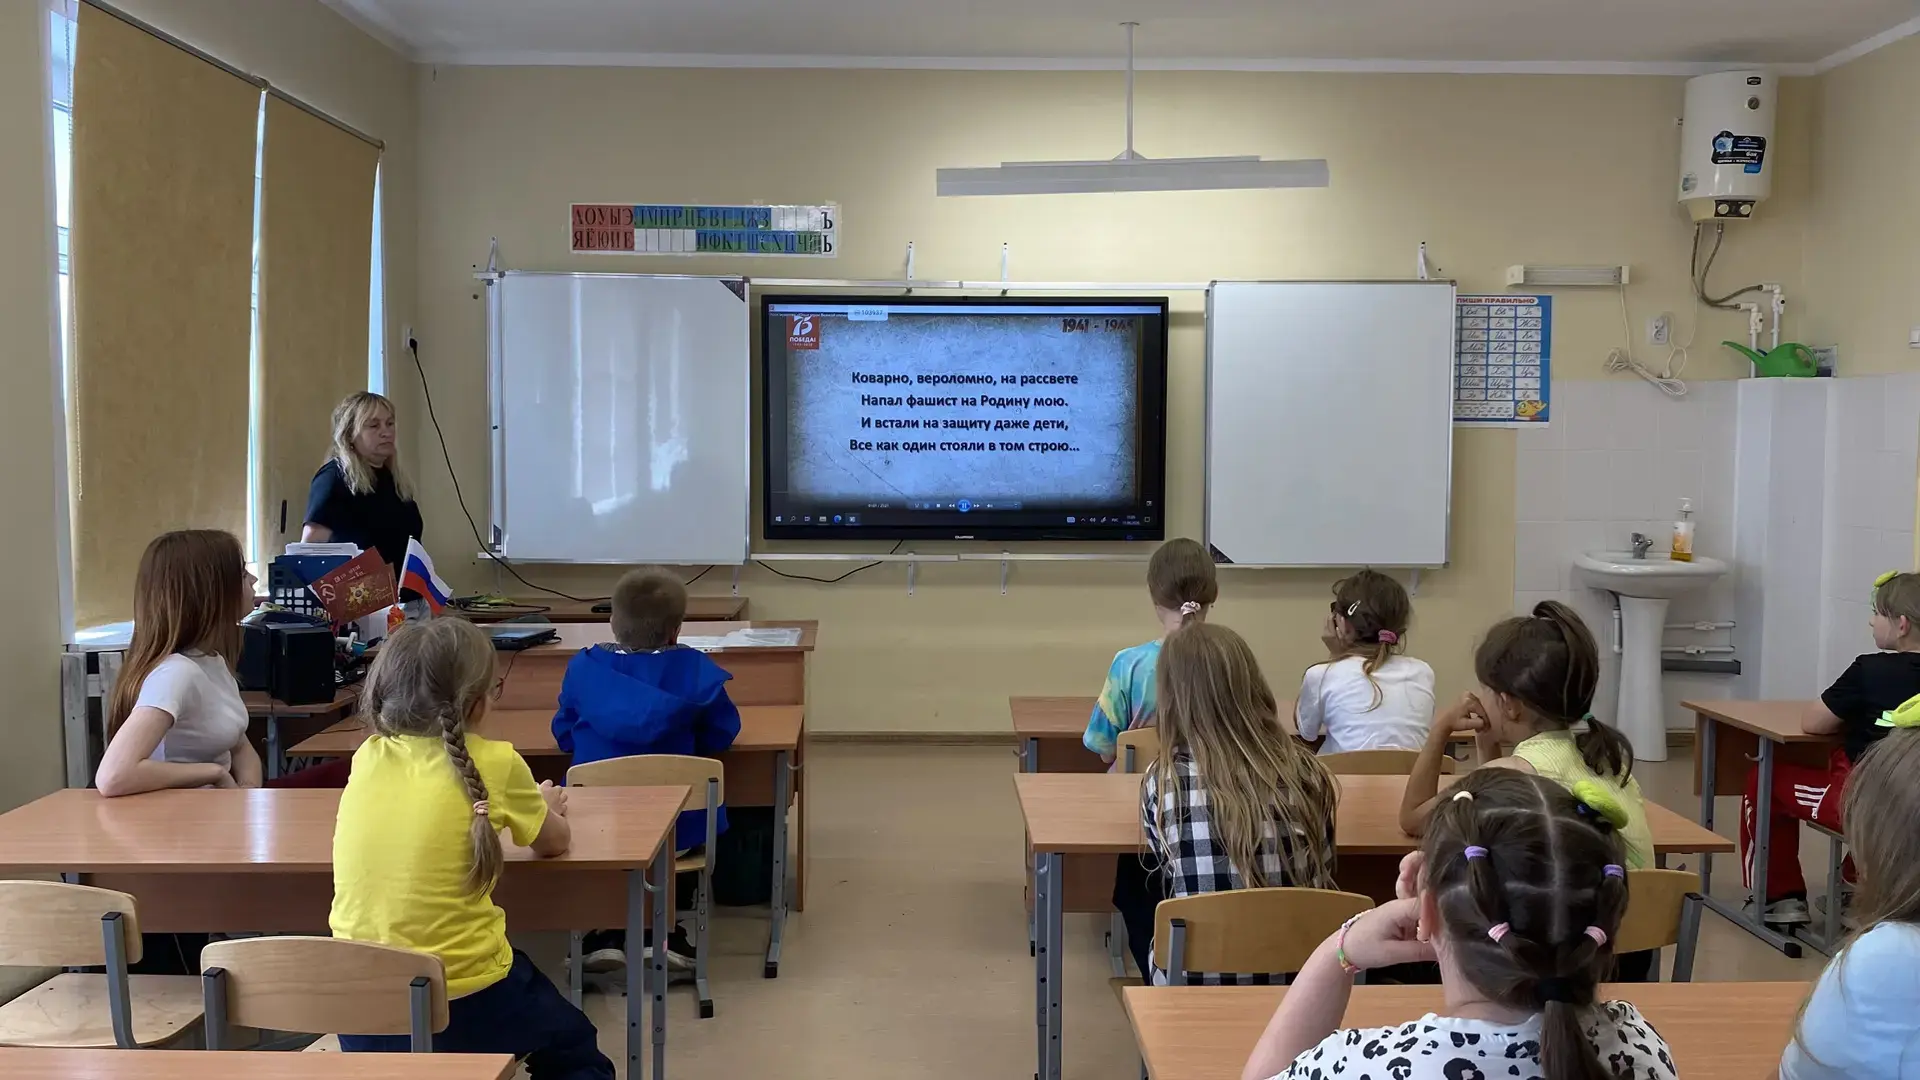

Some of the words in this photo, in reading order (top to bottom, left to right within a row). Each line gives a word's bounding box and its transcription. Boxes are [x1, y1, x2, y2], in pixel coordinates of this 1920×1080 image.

[1062, 318, 1089, 333] 1941
[852, 372, 913, 386] Коварно,
[917, 374, 997, 386] вероломно,
[1000, 375, 1016, 384] на
[1020, 375, 1079, 387] рассвете
[861, 394, 902, 406] Напал
[906, 394, 957, 409] фашист
[961, 397, 977, 406] на
[980, 395, 1030, 409] Родину
[1033, 397, 1069, 407] мою.
[861, 417, 871, 428] И
[875, 419, 919, 429] встали
[922, 419, 939, 429] на
[942, 419, 991, 431] защиту
[993, 419, 1030, 431] даже
[1033, 420, 1069, 431] дети,
[849, 439, 873, 451] Все
[876, 441, 899, 451] как
[902, 441, 936, 453] один
[939, 441, 985, 451] стояли
[988, 442, 996, 451] в
[999, 442, 1025, 451] том
